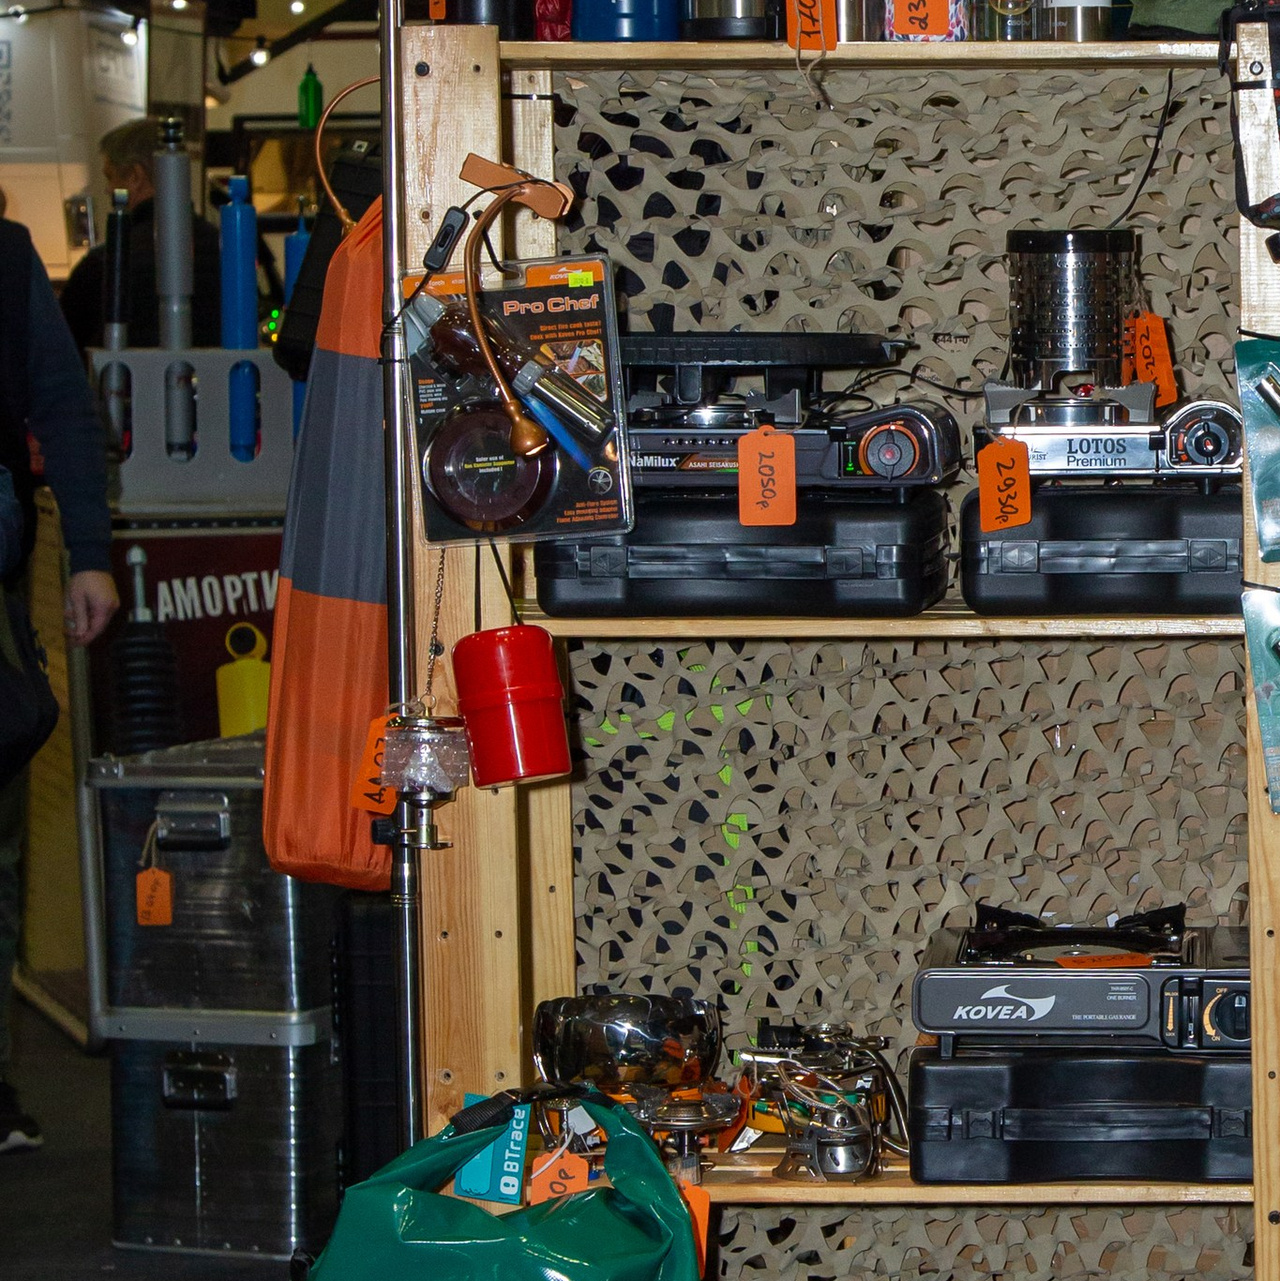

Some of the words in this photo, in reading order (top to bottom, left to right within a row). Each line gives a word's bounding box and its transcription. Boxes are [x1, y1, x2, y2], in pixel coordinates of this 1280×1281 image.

[503, 299, 545, 316] Pro
[547, 294, 599, 313] Chef
[1066, 438, 1127, 454] LOTOS
[1066, 455, 1127, 467] Premium
[953, 1005, 1028, 1020] KOVEA
[1211, 1034, 1221, 1042] ON
[503, 1108, 526, 1173] BTrace
